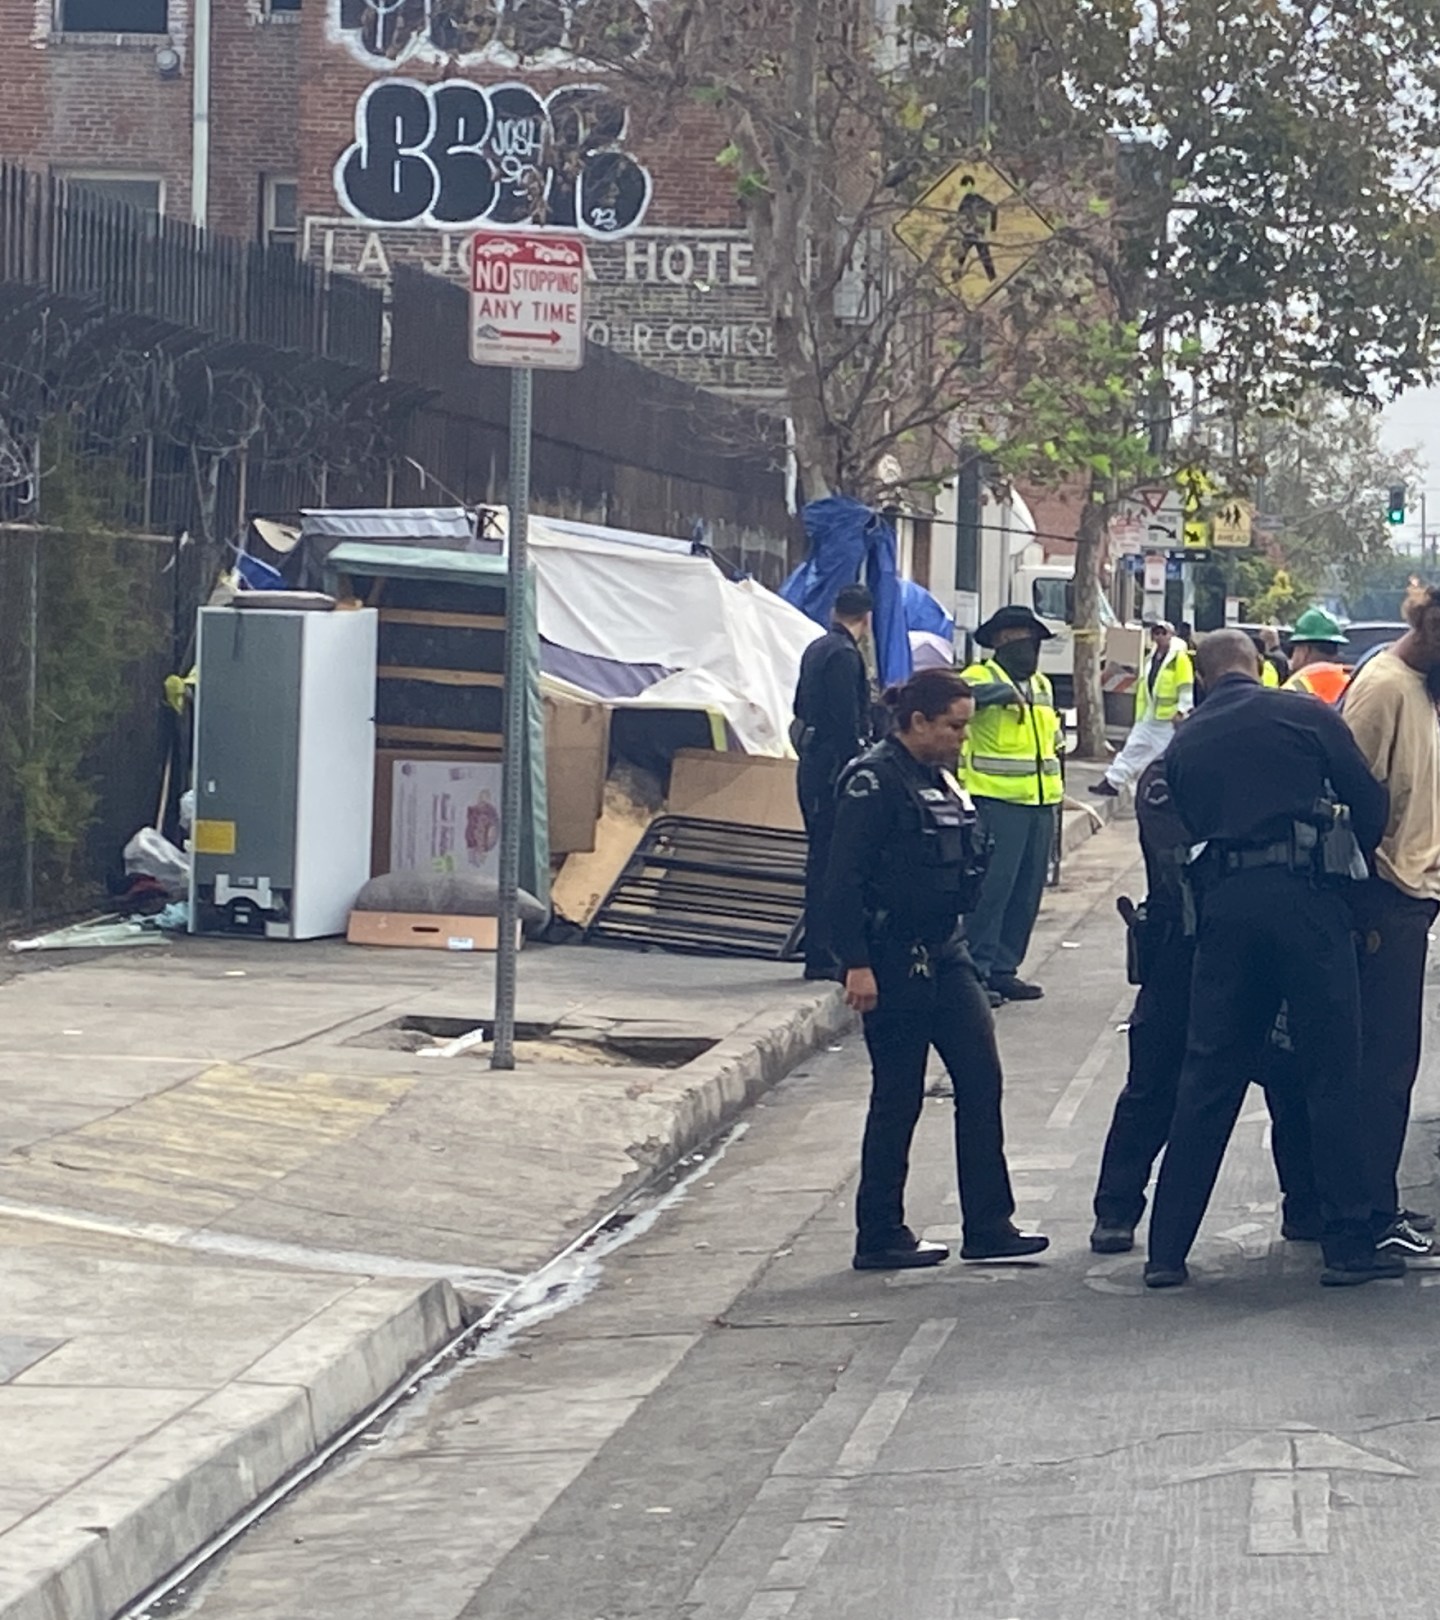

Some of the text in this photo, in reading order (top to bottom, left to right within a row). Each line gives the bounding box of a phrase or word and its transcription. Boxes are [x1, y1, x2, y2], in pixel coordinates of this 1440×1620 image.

[476, 261, 579, 294] NO STOPPING
[624, 240, 758, 286] HOTE
[479, 298, 577, 324] ANY TIME
